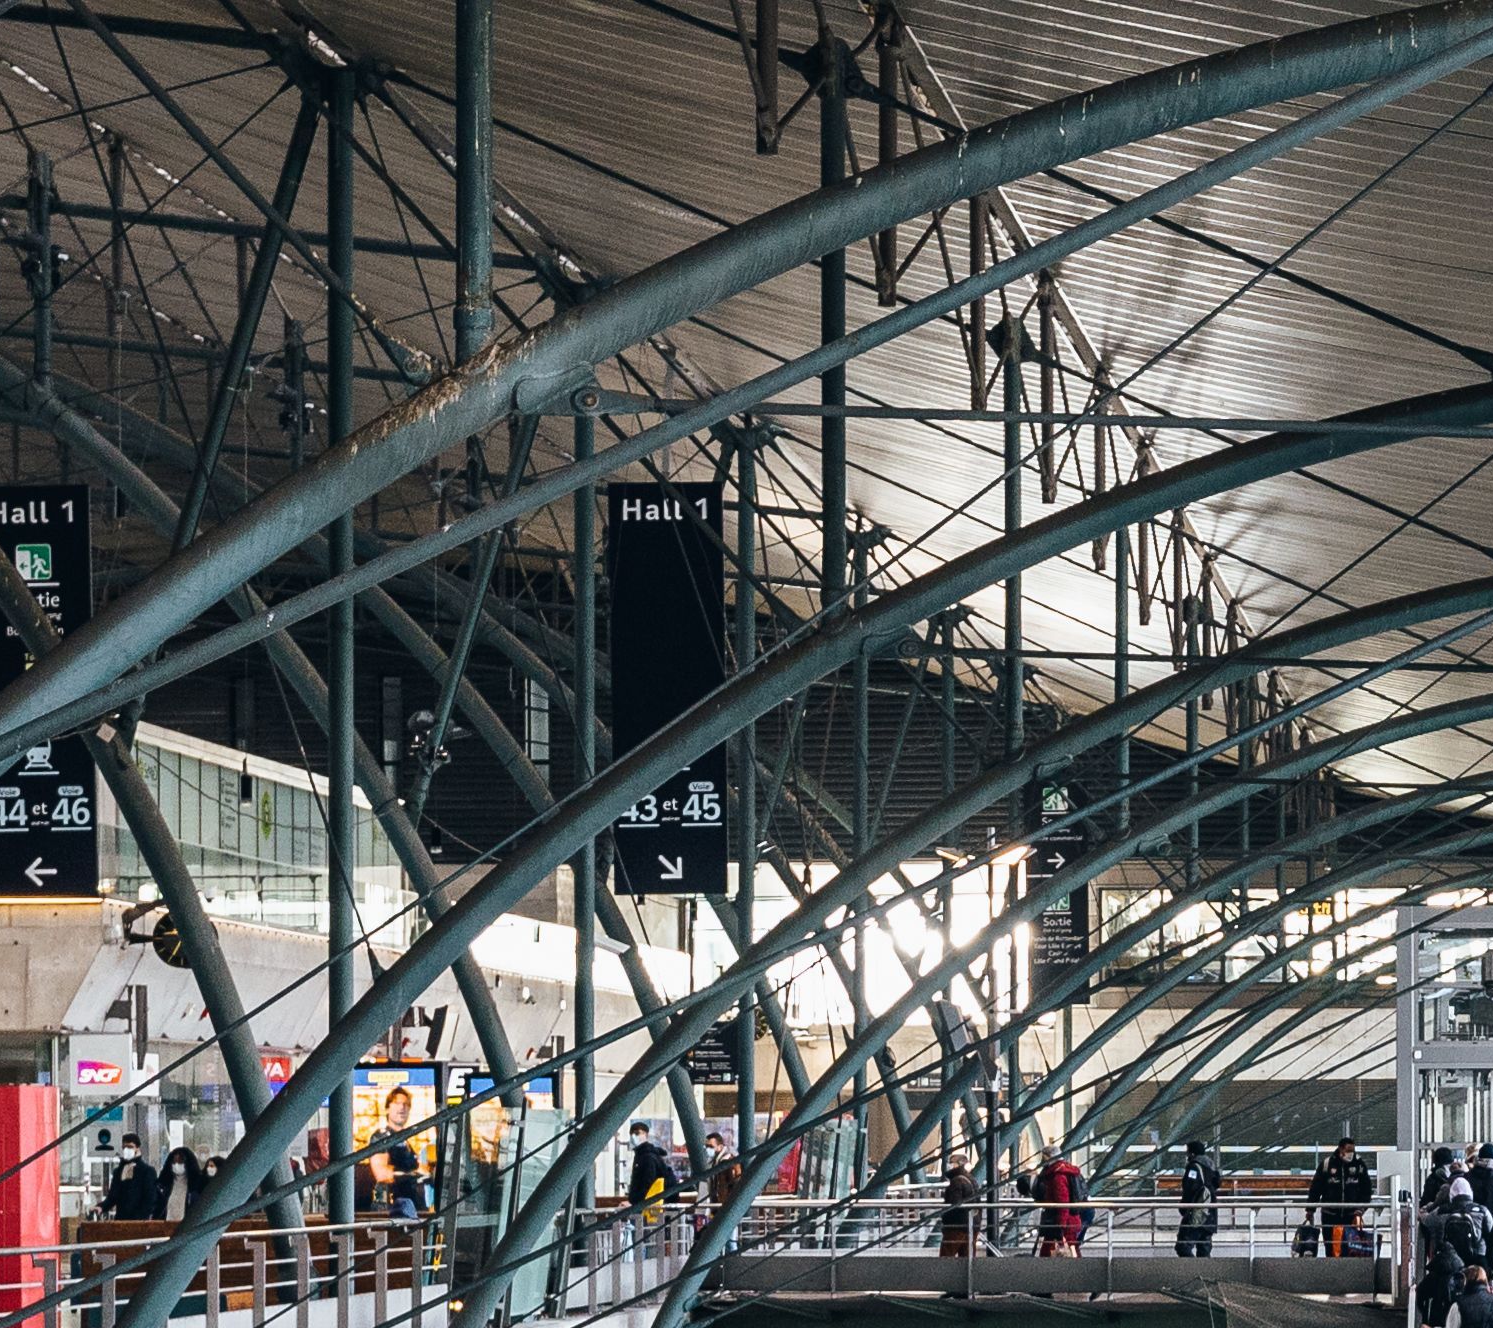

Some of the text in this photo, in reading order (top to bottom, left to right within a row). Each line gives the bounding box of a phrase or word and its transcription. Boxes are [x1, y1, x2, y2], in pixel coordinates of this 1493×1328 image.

[61, 500, 74, 523] 1
[622, 497, 708, 521] Hall 1
[32, 802, 48, 815] et
[51, 797, 91, 825] 46
[621, 793, 721, 821] 43 et 45
[78, 1067, 123, 1084] SNCF
